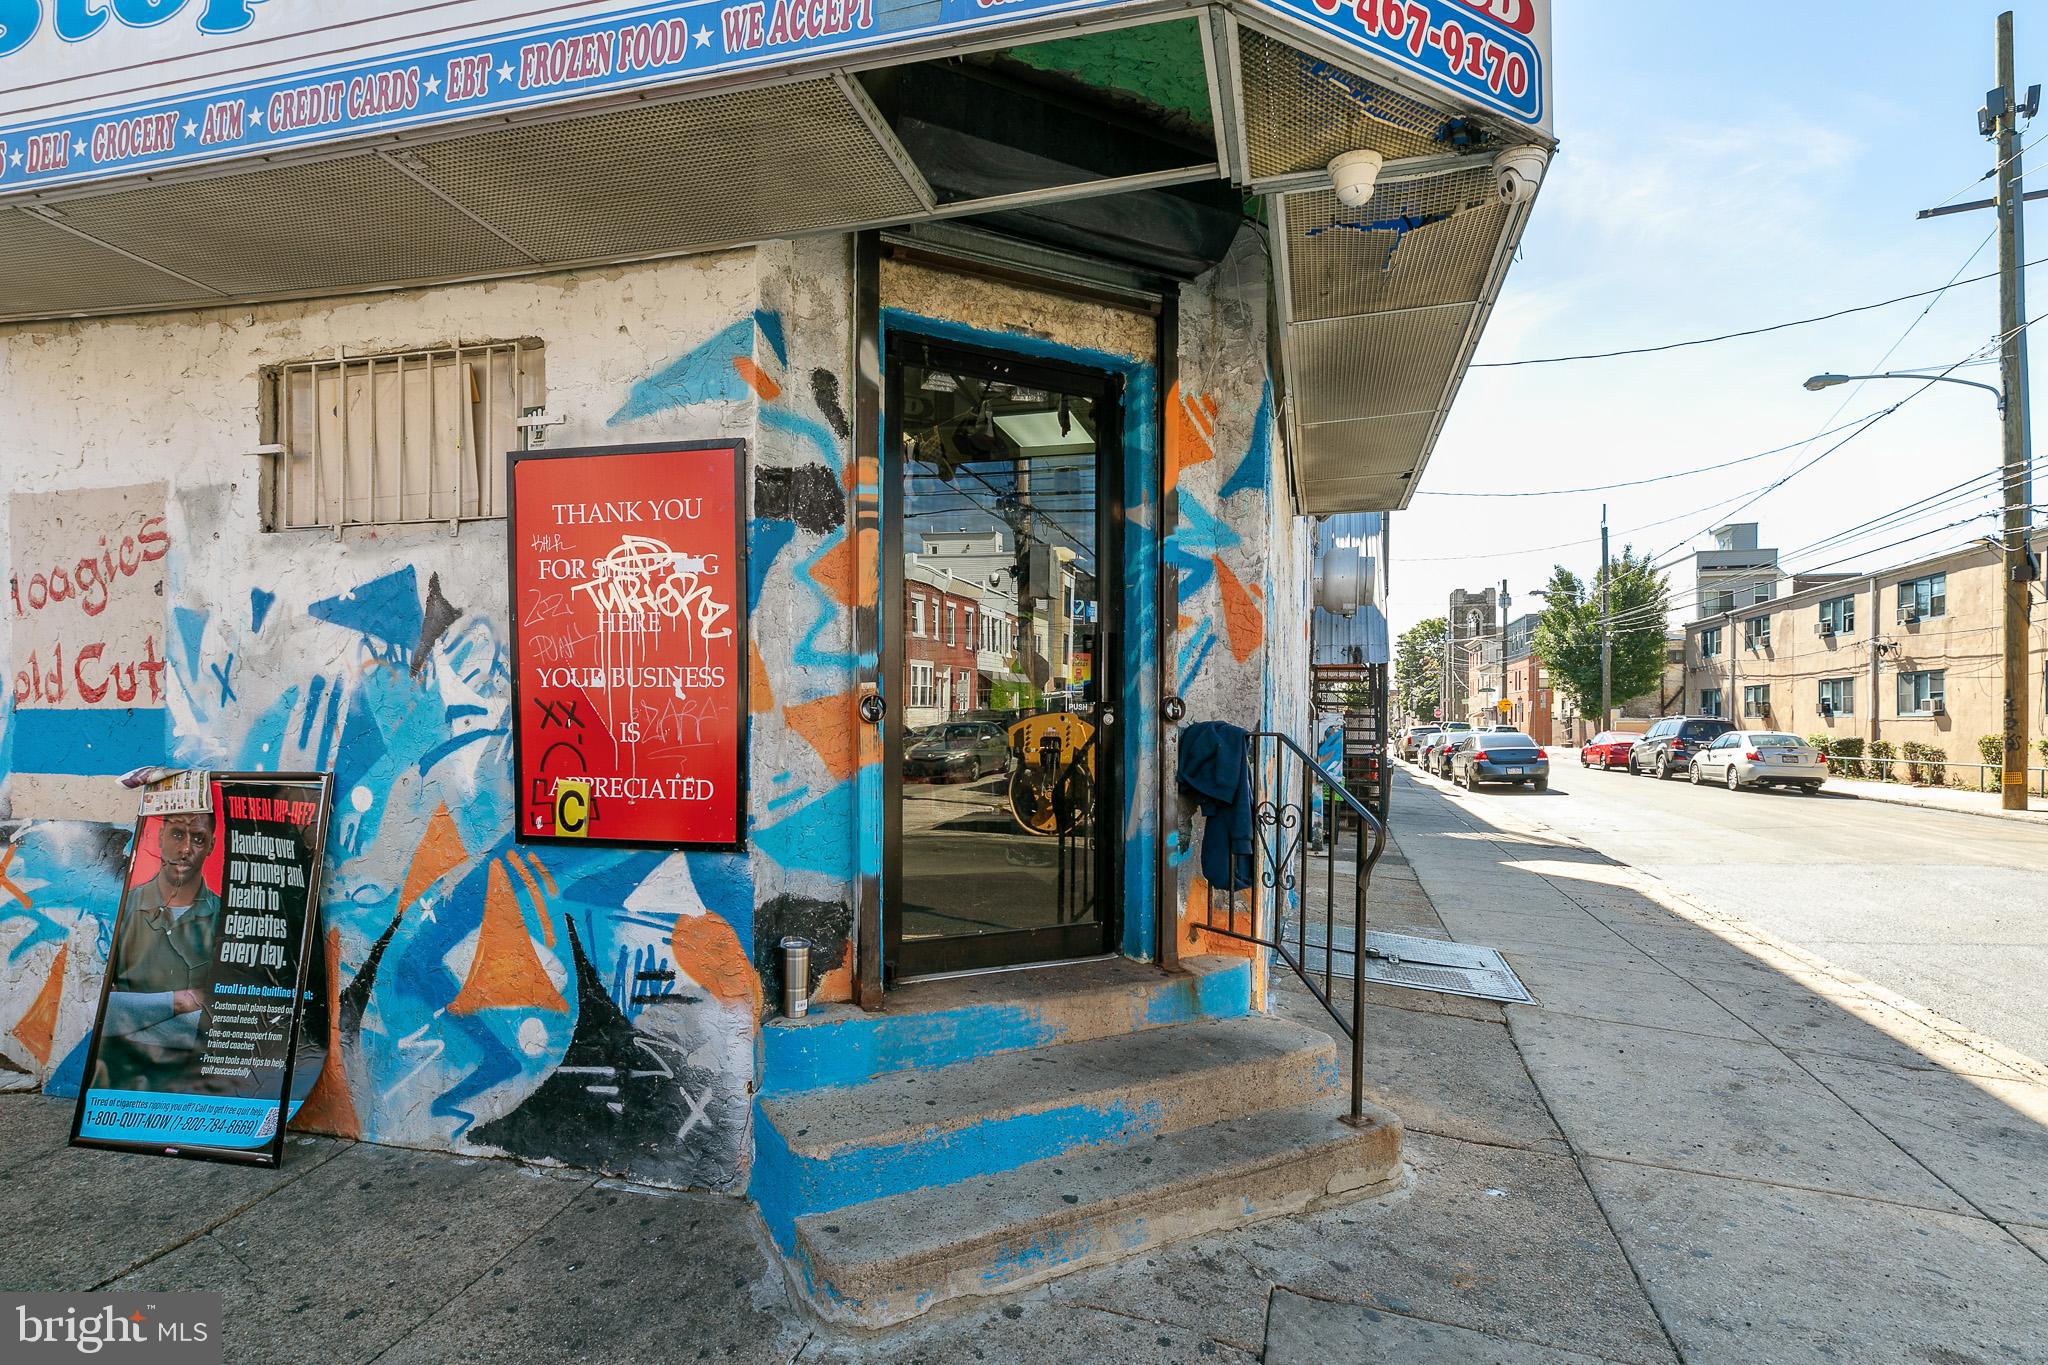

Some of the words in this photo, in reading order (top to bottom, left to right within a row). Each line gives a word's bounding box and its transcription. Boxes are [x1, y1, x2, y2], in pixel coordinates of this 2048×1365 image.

[26, 131, 71, 173] DELI
[91, 112, 179, 163] GROCERY
[200, 100, 244, 145] ATM
[267, 81, 347, 133] CREDIT
[348, 68, 420, 117] CARDS
[446, 55, 492, 101] EBT
[519, 31, 613, 89] FROZEN
[617, 20, 686, 71] FOOD
[721, 4, 765, 54] WE
[552, 501, 642, 525] THANK
[648, 498, 702, 521] YOU
[538, 558, 586, 580] FOR
[597, 612, 662, 633] HERE
[536, 668, 606, 688] YOUR
[612, 666, 725, 688] BUSINESS
[1068, 703, 1088, 711] PUSH
[620, 722, 641, 742] IS
[228, 796, 247, 819] THE
[248, 796, 272, 820] REAL
[273, 799, 317, 826] RIP-OFF?
[559, 790, 585, 832] C
[231, 830, 276, 861] Handing
[276, 838, 295, 860] over
[229, 860, 248, 884] my
[250, 861, 286, 888] money
[287, 864, 305, 888] and
[227, 884, 266, 910] health
[267, 888, 279, 910] to
[224, 911, 287, 939] cigarettes
[220, 942, 259, 967] every
[260, 941, 287, 969] day.
[214, 983, 238, 994] Enroll
[239, 983, 246, 994] in
[247, 984, 260, 996] the
[261, 985, 291, 998] Quitline
[214, 1001, 237, 1011] Custom
[237, 1003, 250, 1014] quit
[249, 1003, 267, 1013] plans
[267, 1004, 285, 1014] based
[212, 1014, 239, 1024] personal
[239, 1016, 258, 1024] needs
[207, 1039, 230, 1049] trained
[230, 1041, 255, 1051] coaches
[208, 1028, 244, 1039] One-on-one
[244, 1031, 267, 1041] support
[267, 1031, 283, 1041] from
[203, 1053, 224, 1064] Proven
[224, 1055, 240, 1065] tools
[240, 1057, 252, 1066] and
[252, 1057, 264, 1067] tips
[264, 1058, 271, 1067] to
[200, 1065, 215, 1075] quit
[214, 1066, 252, 1078] successfully
[91, 1097, 109, 1107] Tired
[109, 1097, 116, 1107] of
[116, 1098, 148, 1109] cigarettes
[149, 1101, 171, 1112] ripping
[170, 1103, 182, 1112] you
[182, 1102, 196, 1111] off?
[196, 1103, 208, 1113] Call
[207, 1104, 214, 1113] to
[213, 1105, 224, 1115] get
[224, 1105, 237, 1115] free
[237, 1107, 250, 1117] quit
[86, 1110, 172, 1129] 1-800-QUIT-NOW
[169, 1115, 259, 1137] (1-800-784-8669)
